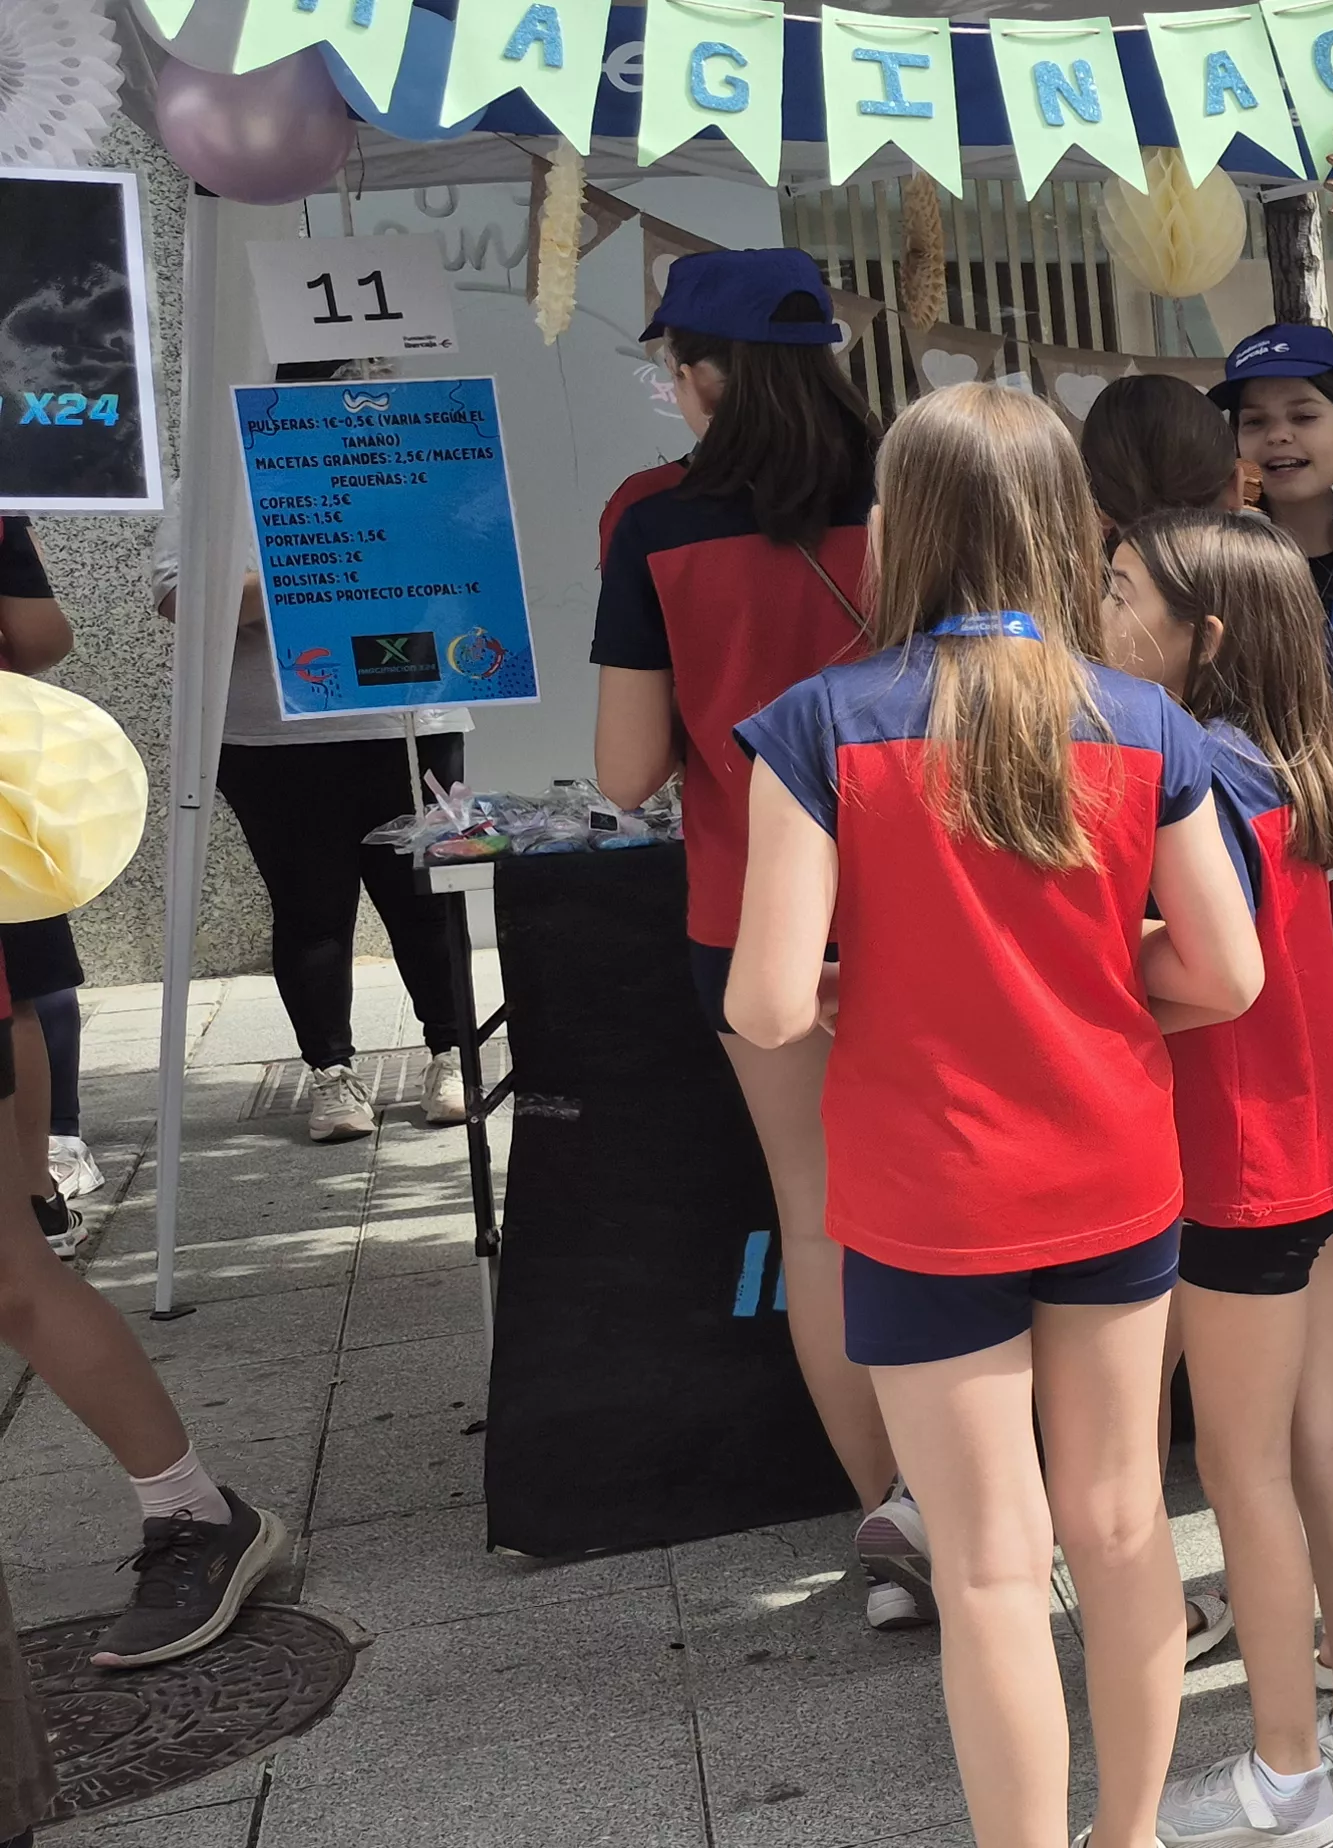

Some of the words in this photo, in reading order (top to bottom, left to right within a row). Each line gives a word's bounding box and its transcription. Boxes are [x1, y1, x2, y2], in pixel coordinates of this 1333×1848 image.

[307, 270, 403, 324] 11
[20, 391, 119, 427] X24
[248, 417, 320, 433] PULSERAS:
[378, 413, 421, 428] (VARIA
[425, 408, 467, 425] SEGÚN
[470, 410, 485, 423] EL
[342, 433, 401, 449] TAMAÑO)
[255, 456, 319, 470] MACETAS
[323, 452, 392, 467] GRANDES:
[395, 447, 493, 464] 2,5€/MACETAS
[331, 471, 407, 488] PEQUEÑAS:
[410, 472, 428, 485] 2€
[260, 495, 318, 510] COFRES:
[320, 493, 351, 508] 2,5€
[262, 512, 311, 527] VELAS:
[313, 511, 343, 525] 1,5€
[265, 531, 354, 548] PORTAVELAS:
[357, 529, 387, 544] 1,5€
[270, 552, 343, 568] LLAVEROS:
[345, 551, 363, 564] 2€
[273, 573, 340, 588] BOLSITAS:
[343, 571, 359, 584] 1€
[274, 591, 333, 606] PIEDRAS
[336, 586, 403, 602] PROYECTO
[407, 584, 462, 598] ECOPAL:
[465, 582, 481, 595] 1€
